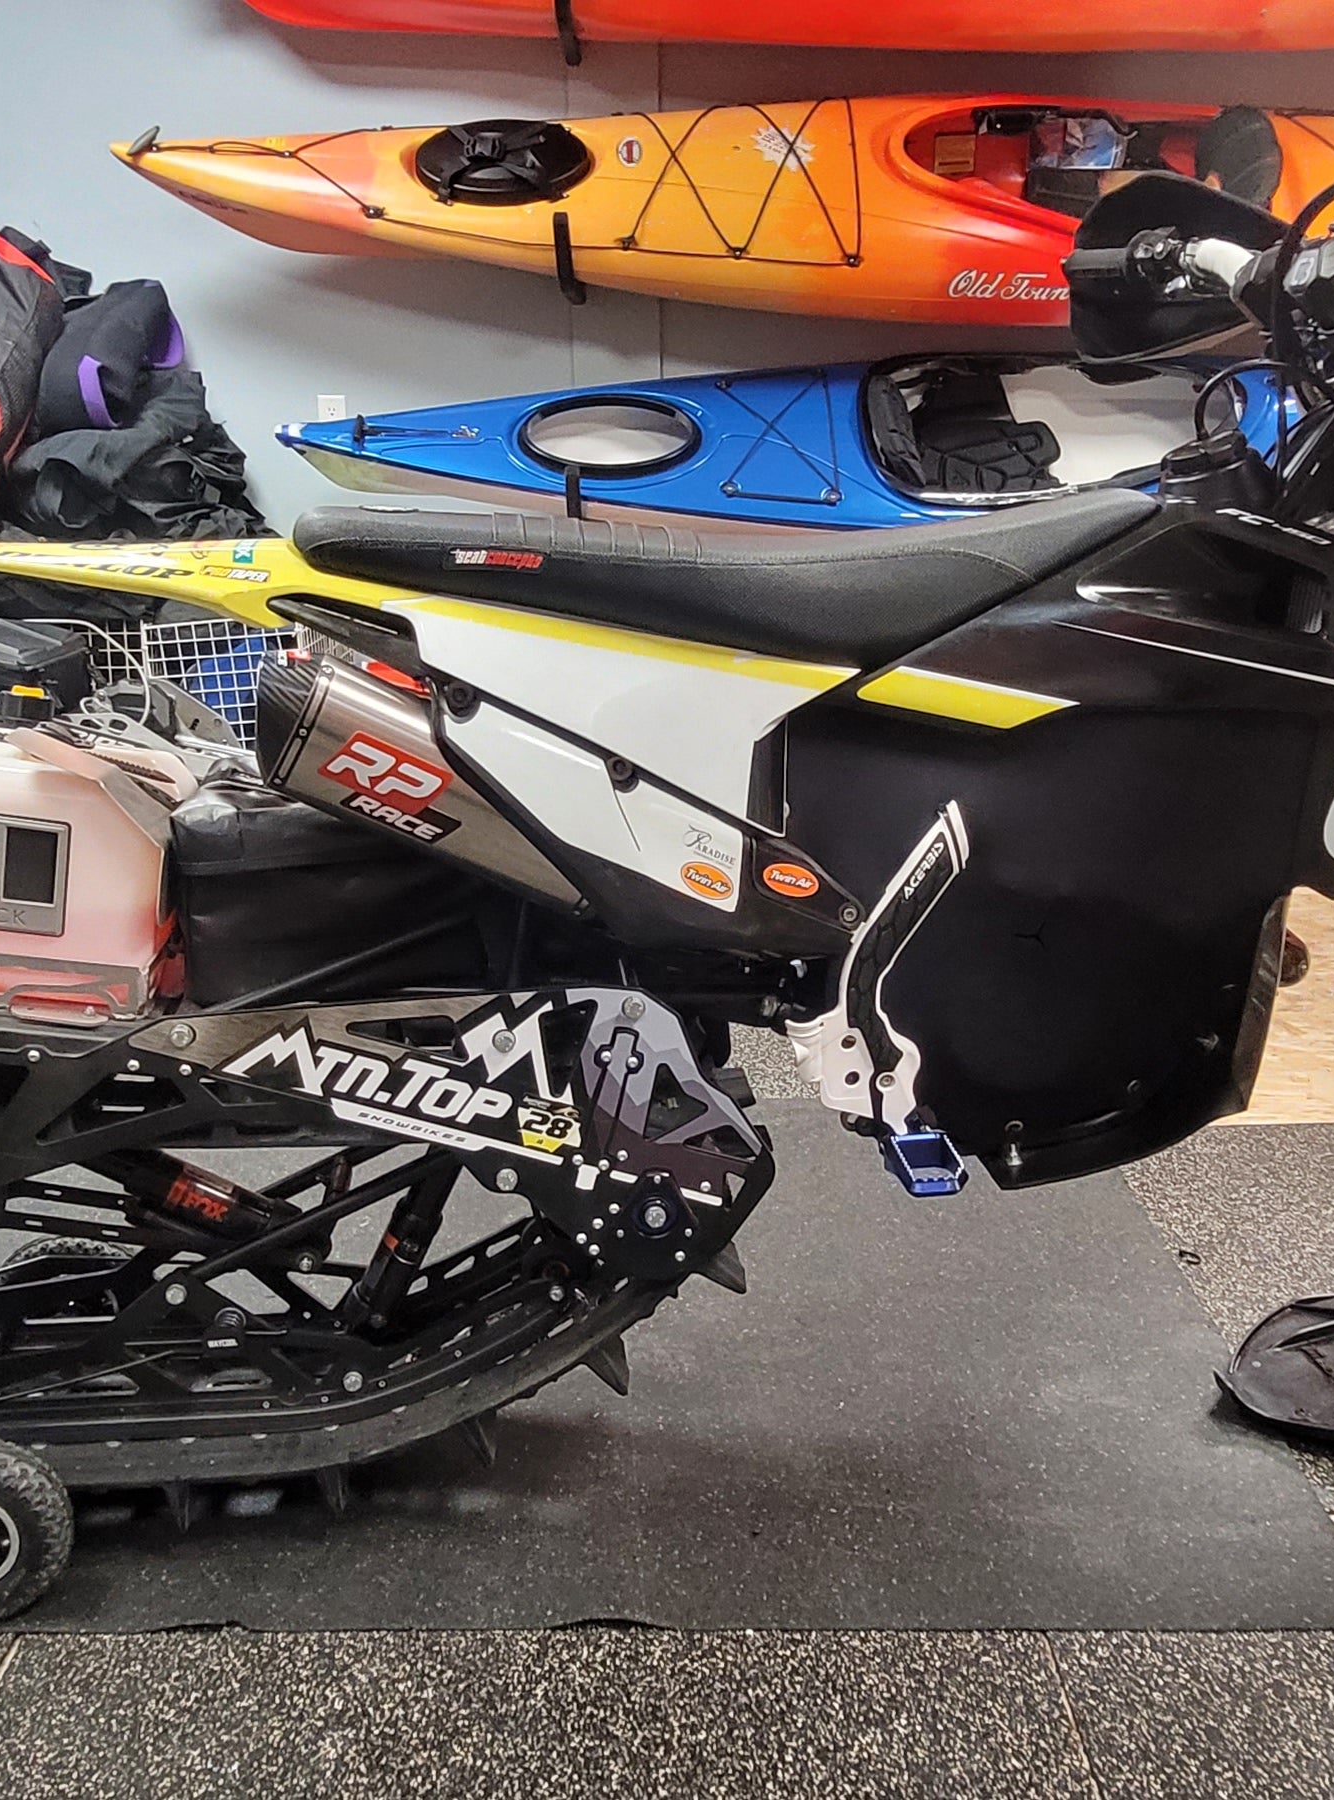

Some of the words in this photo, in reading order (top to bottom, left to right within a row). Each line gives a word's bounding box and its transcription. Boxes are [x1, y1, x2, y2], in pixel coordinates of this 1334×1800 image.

[948, 269, 1005, 298] Old
[999, 272, 1070, 300] Town
[1215, 507, 1276, 526] FC
[326, 740, 443, 799] RP
[349, 794, 444, 841] RACE
[682, 824, 737, 866] PARADISE
[685, 867, 713, 886] Twin
[710, 880, 730, 894] Air
[770, 869, 797, 886] Twin
[795, 877, 815, 890] Air
[903, 842, 945, 901] ACERBIS
[357, 1111, 467, 1143] SNOWBIKES
[522, 1110, 574, 1139] 28
